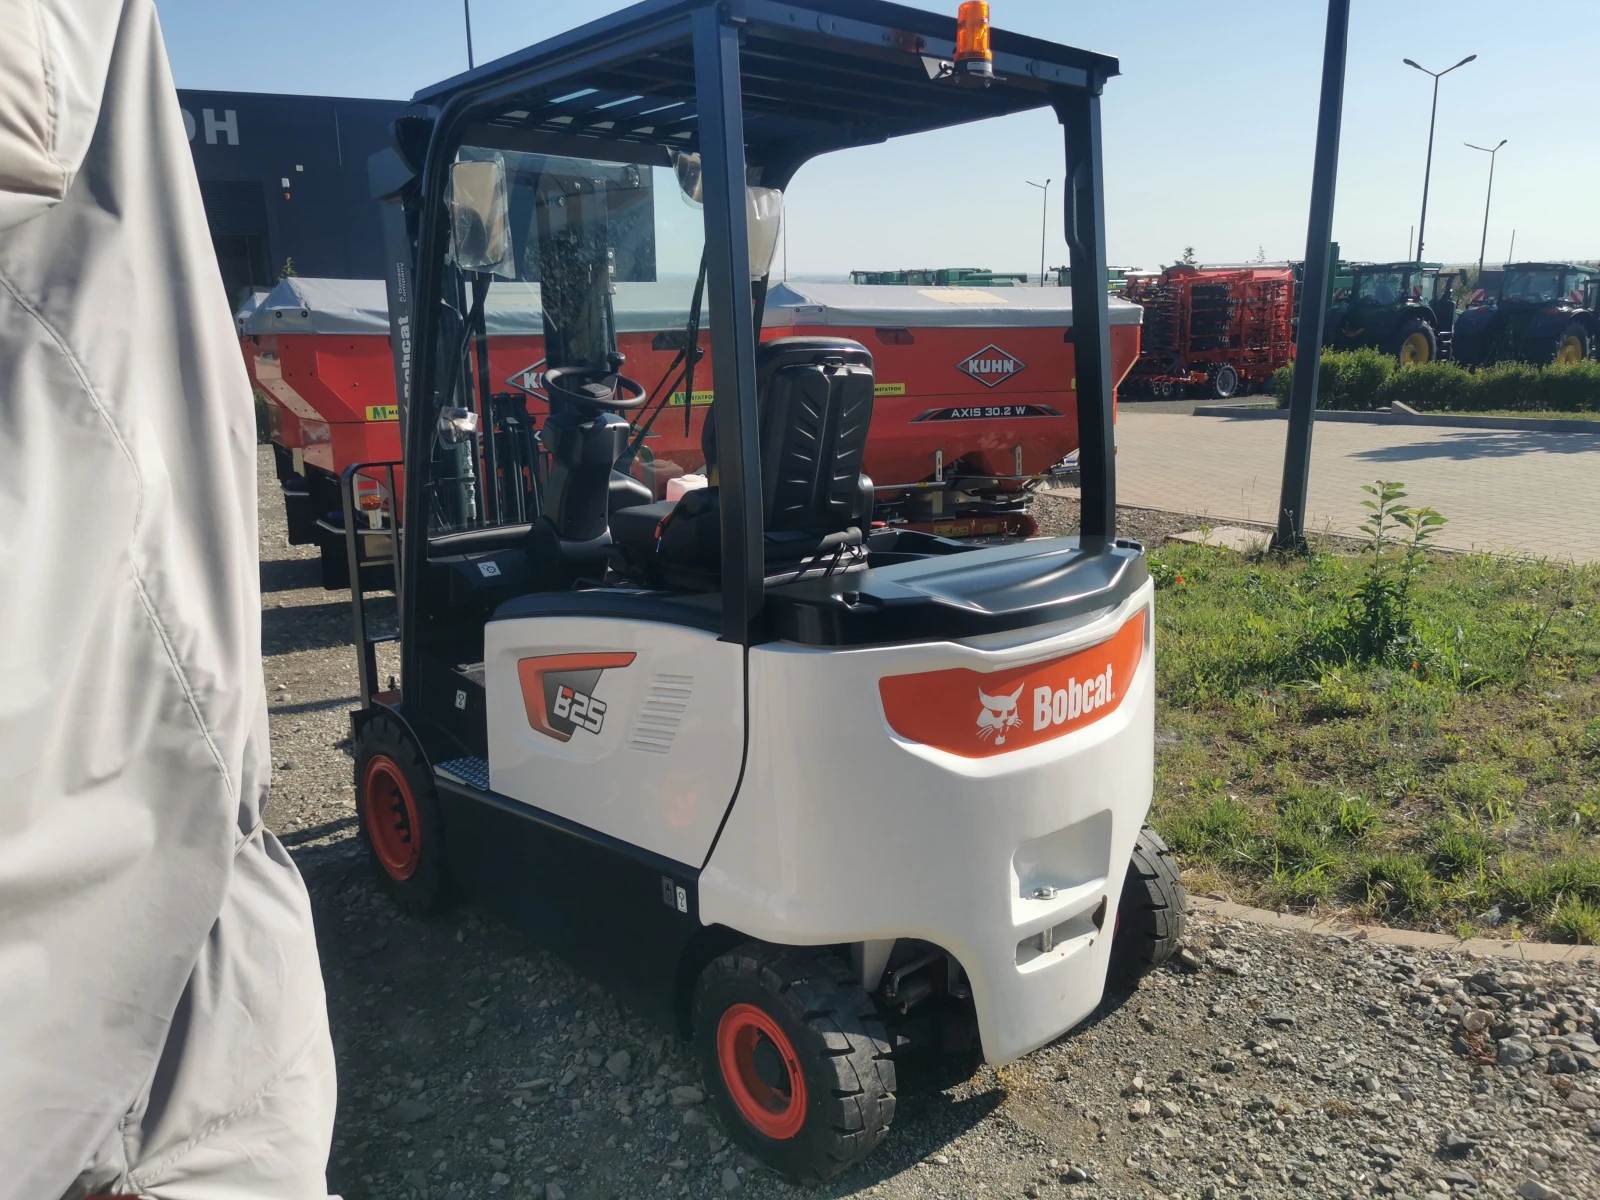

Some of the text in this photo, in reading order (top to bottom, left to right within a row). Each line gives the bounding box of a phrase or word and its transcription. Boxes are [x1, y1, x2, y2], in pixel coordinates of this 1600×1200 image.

[968, 359, 1014, 373] KUHN
[951, 406, 1026, 417] AXIS 30.2 W
[1033, 662, 1113, 731] Bobcat
